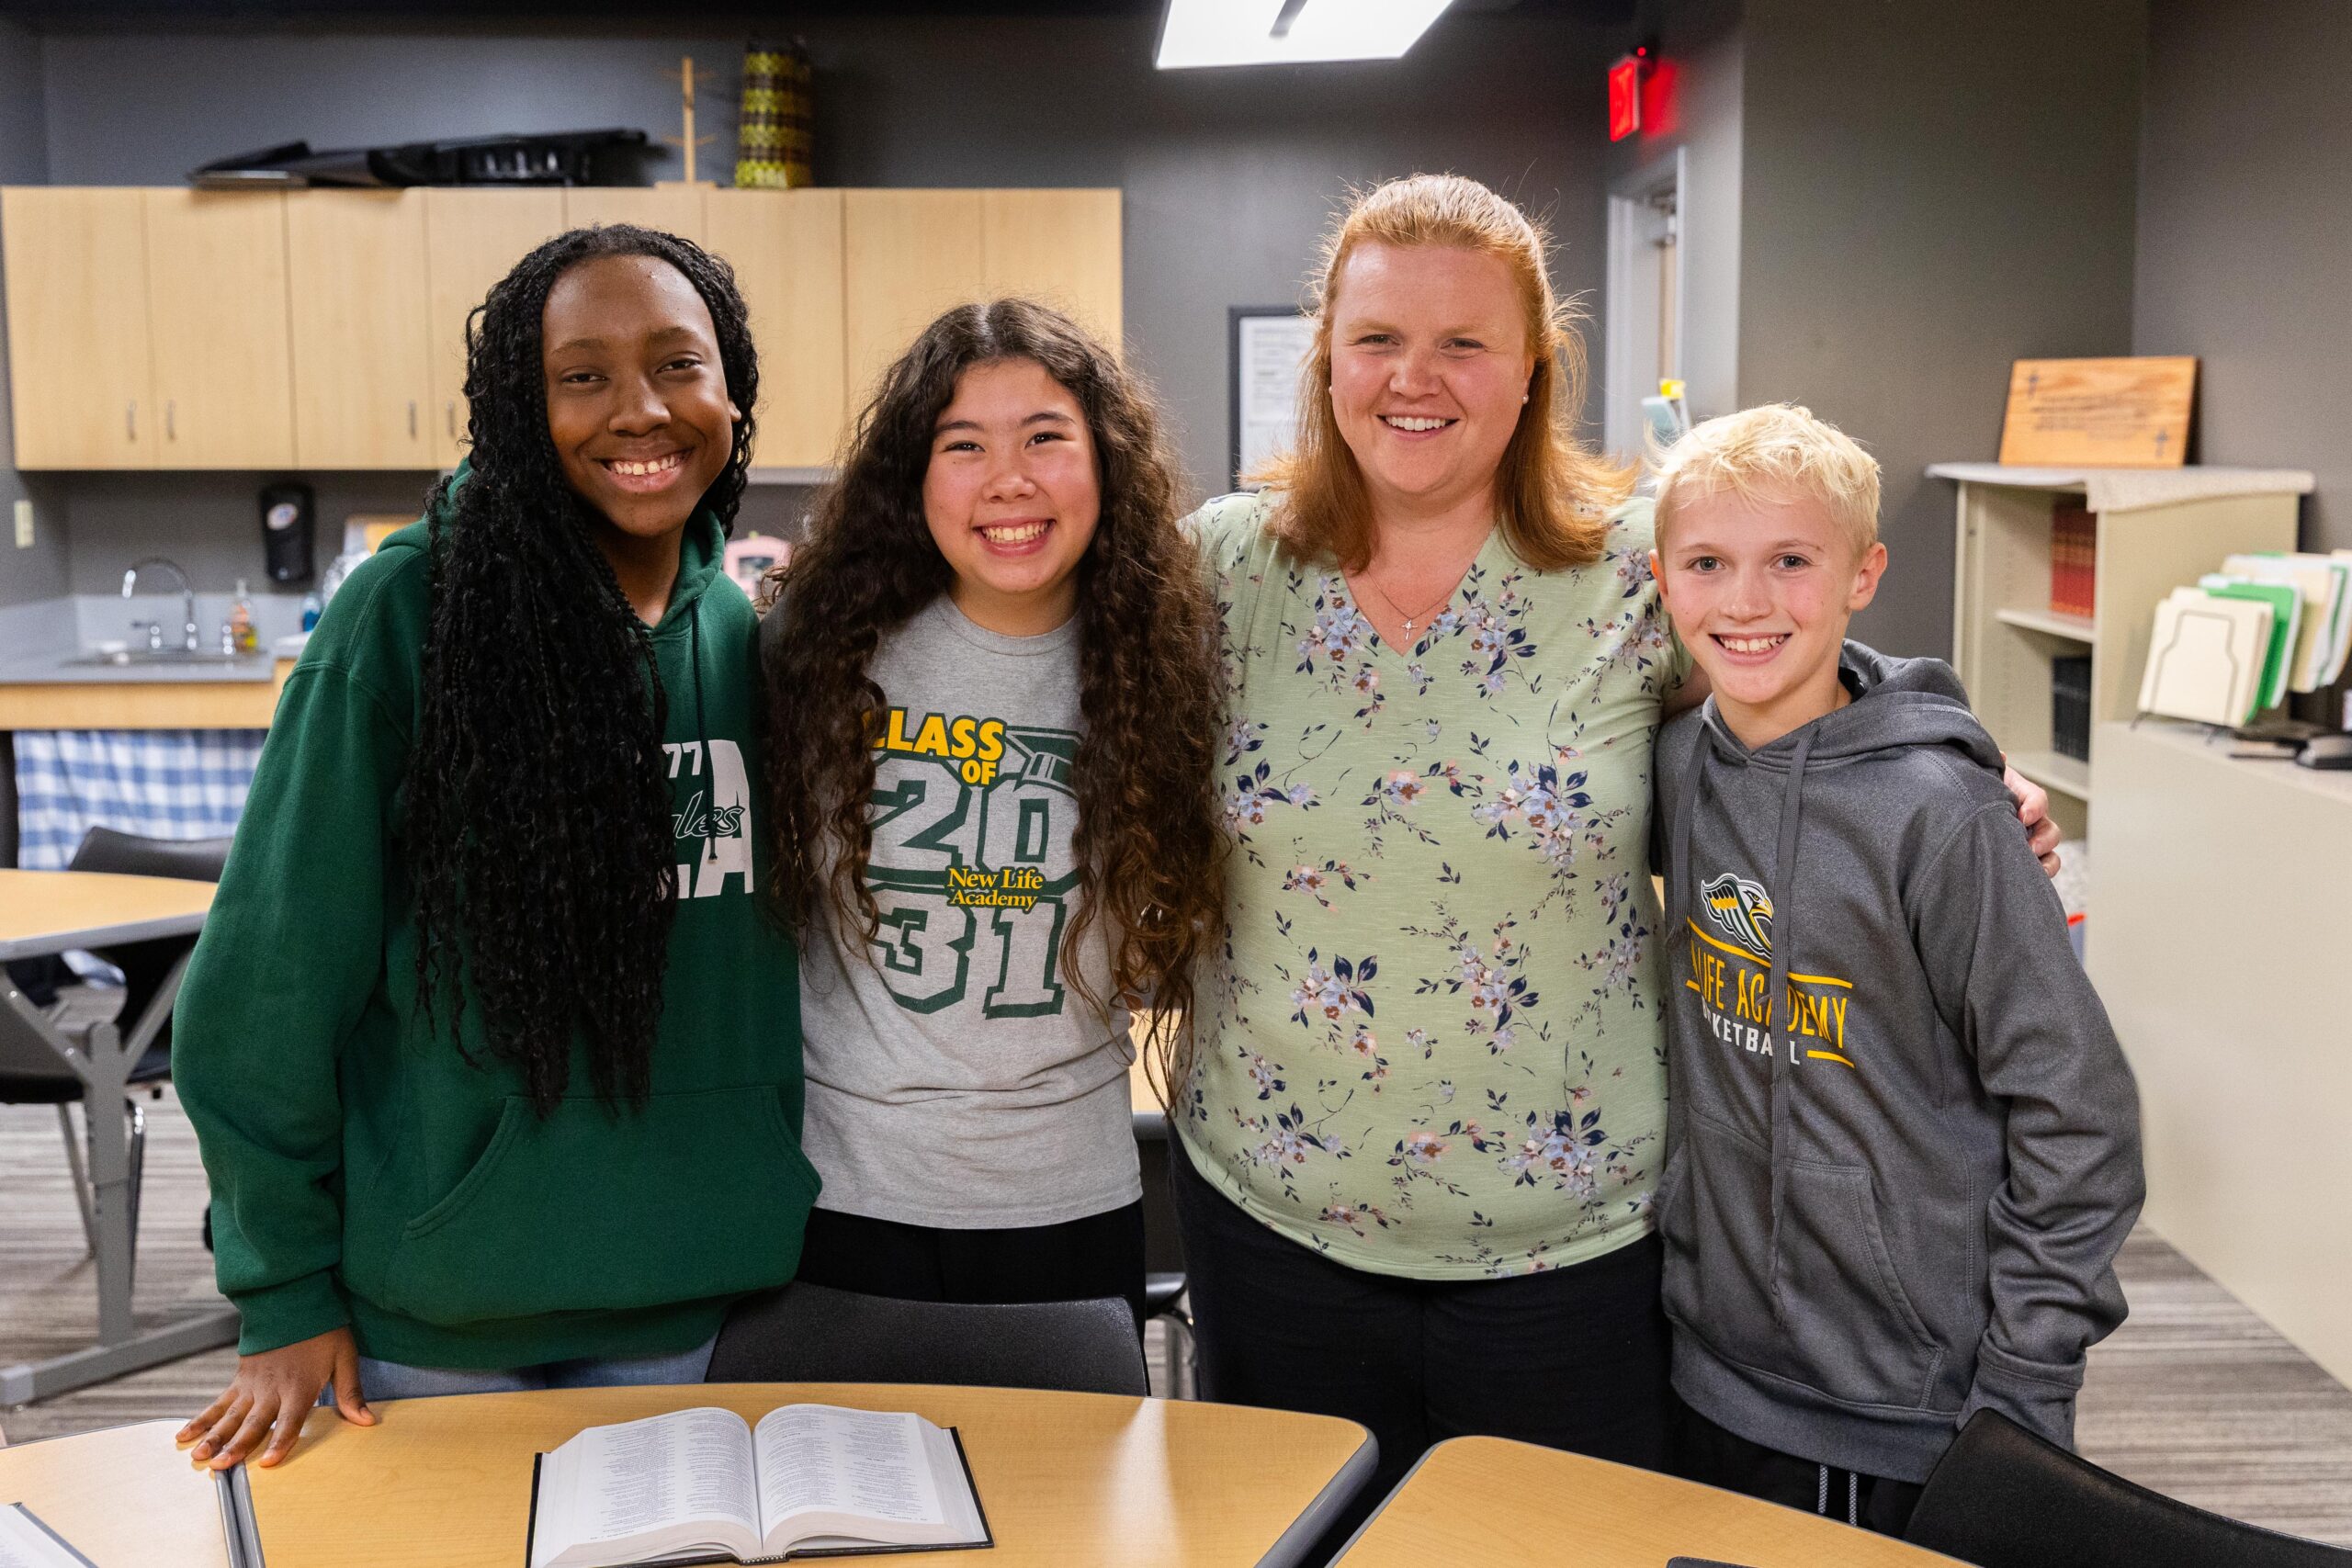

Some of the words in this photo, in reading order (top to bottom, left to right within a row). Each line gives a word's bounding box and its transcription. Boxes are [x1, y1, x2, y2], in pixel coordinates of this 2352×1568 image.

[961, 759, 996, 785] OF
[865, 753, 1080, 882] 20
[947, 868, 999, 887] New
[1001, 869, 1044, 890] Life
[950, 889, 1038, 912] Academy
[859, 884, 1068, 1021] 31
